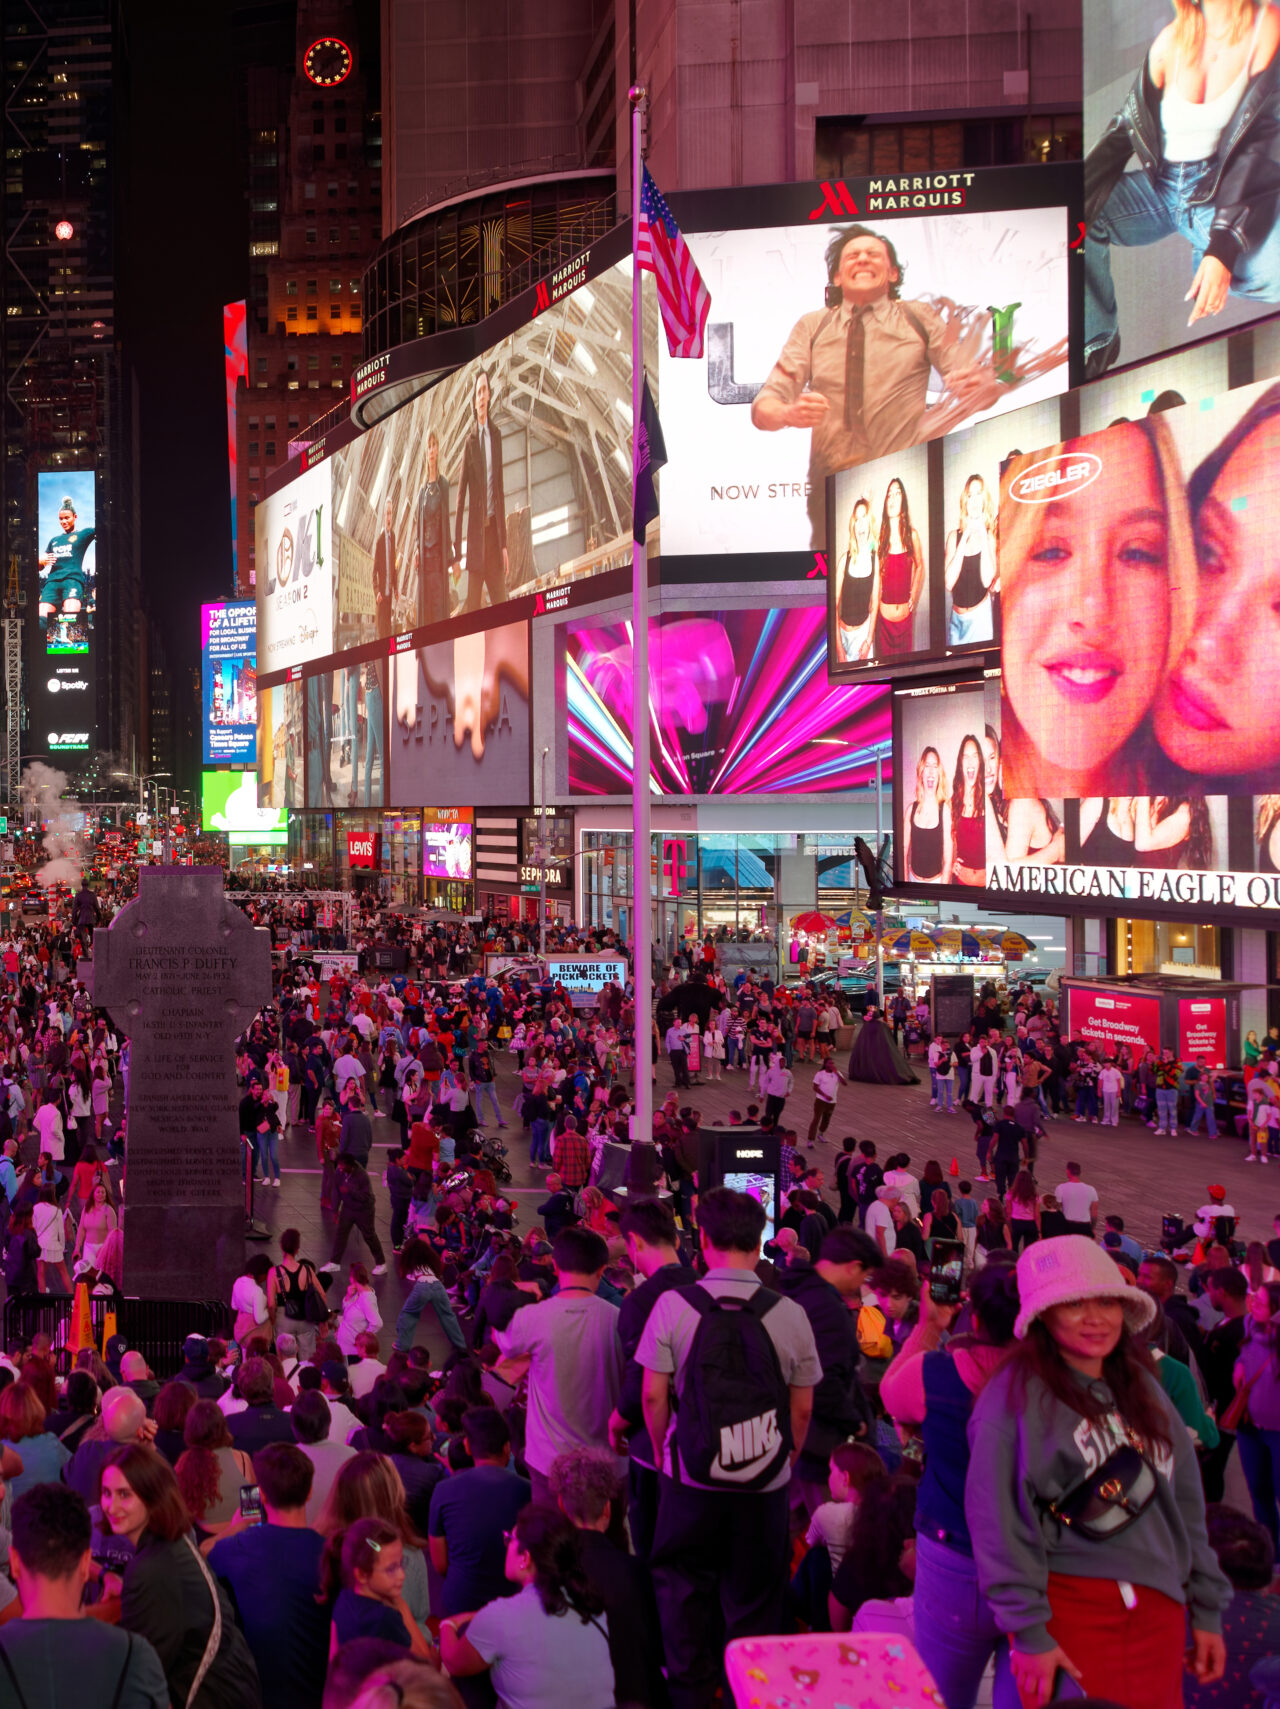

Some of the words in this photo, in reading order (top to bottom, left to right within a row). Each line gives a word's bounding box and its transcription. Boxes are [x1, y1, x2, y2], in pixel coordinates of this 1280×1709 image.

[869, 172, 976, 194] MARRIOTT
[869, 190, 963, 210] MARQUIS
[552, 250, 591, 286] MARRIOTT
[552, 269, 586, 301] MARQUIS
[357, 353, 390, 383] MARRIOTT
[357, 371, 385, 396] MARQUIS
[1019, 460, 1091, 496] ZIEGLER
[711, 484, 751, 502] NOW
[758, 483, 815, 500] STRE
[303, 584, 308, 599] 2
[546, 586, 571, 600] MARRIOTT
[546, 597, 568, 610] MARQUIS
[209, 609, 227, 619] THE
[209, 619, 221, 628] OF
[223, 618, 229, 627] A
[220, 635, 249, 643] BROADWAY
[61, 680, 89, 691] Spotify
[929, 686, 948, 694] PORTRA
[521, 866, 562, 883] SEPHORA
[988, 864, 1128, 899] AMERICAN
[1141, 871, 1237, 905] EAGLE
[136, 946, 186, 955] LIEUTENANT
[188, 946, 230, 955] COLONEL
[129, 958, 180, 969] FRANCIS
[559, 964, 601, 973] BEWARE
[605, 964, 618, 973] OF
[143, 986, 187, 996] CATHOLIC
[191, 986, 222, 995] PRIEST
[162, 1008, 204, 1017] CHAPLAIN
[1088, 1016, 1102, 1027] Get
[1102, 1019, 1140, 1034] Broadway
[1081, 1027, 1105, 1039] tickets
[1106, 1031, 1113, 1039] in
[1114, 1033, 1147, 1046] seconds.
[144, 1055, 151, 1063] A
[154, 1055, 171, 1063] LIFE
[174, 1055, 185, 1063] OF
[190, 1055, 224, 1063] SERVICE
[141, 1072, 160, 1081] GOD
[163, 1072, 183, 1080] AND
[186, 1072, 226, 1081] COUNTRY
[736, 1149, 764, 1158] HOPE
[719, 1410, 782, 1466] NIKE
